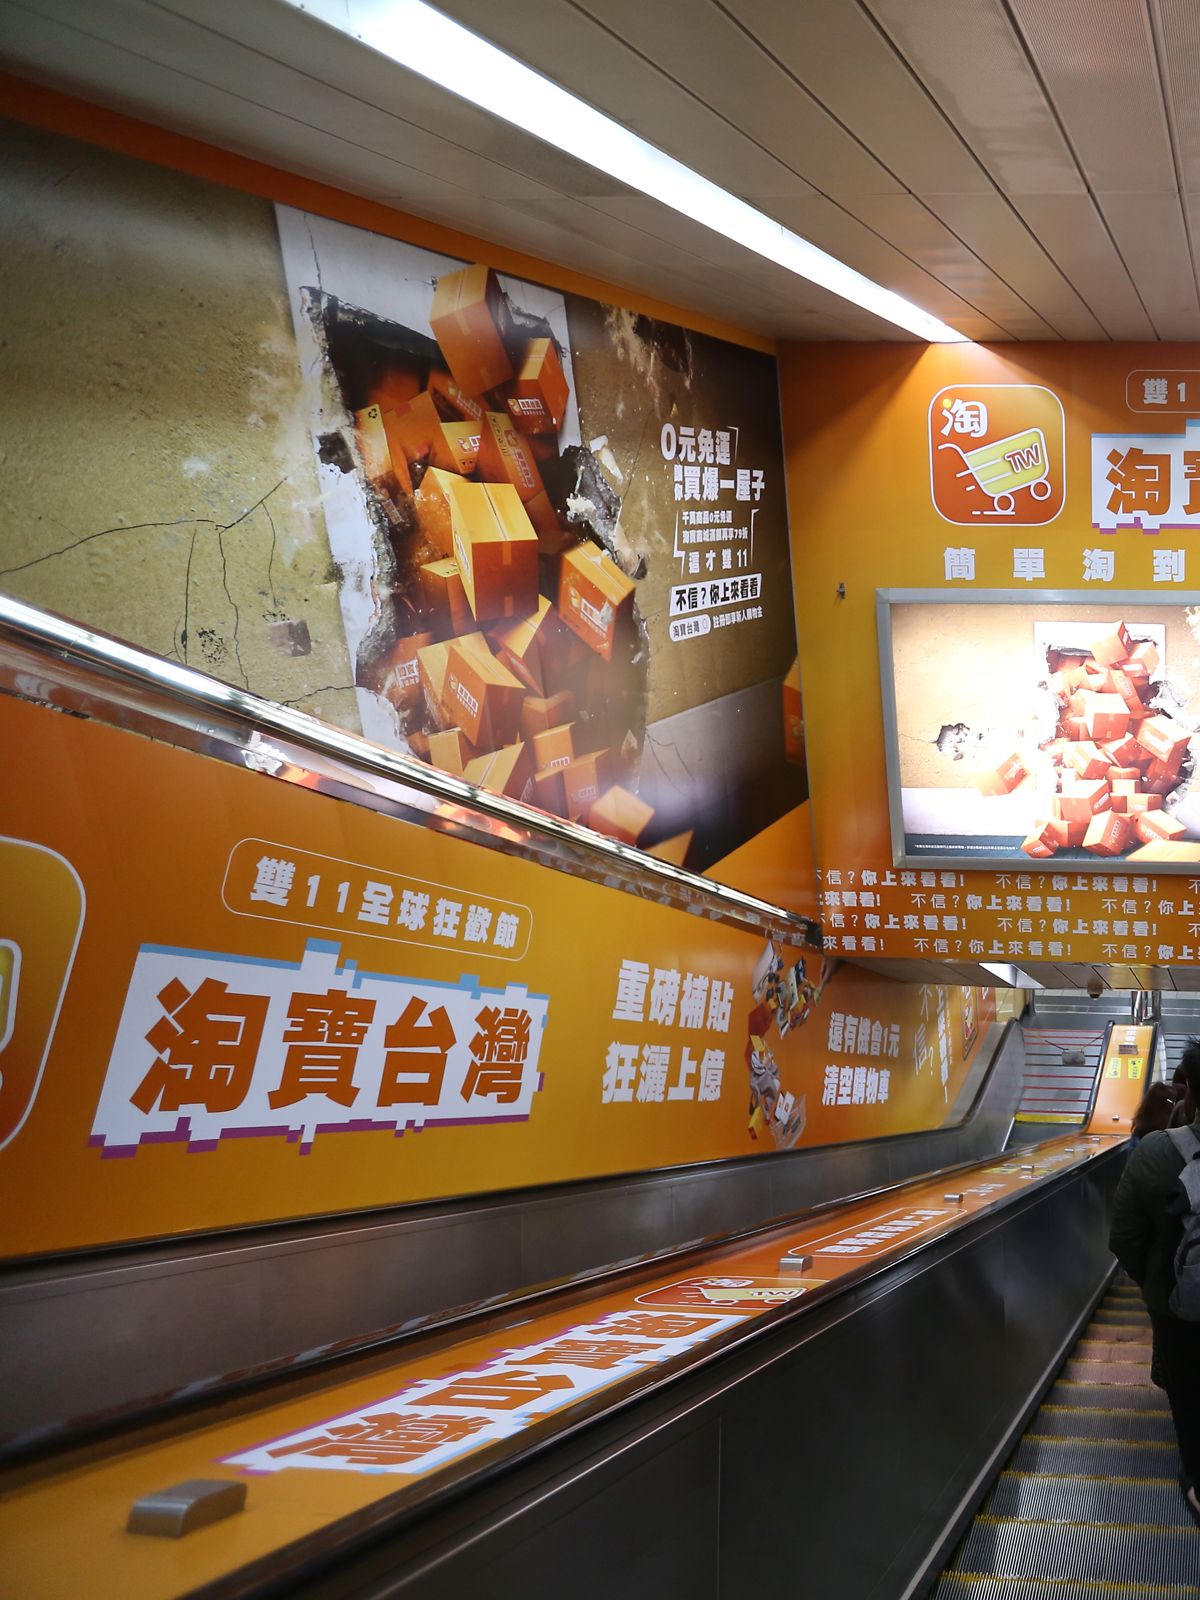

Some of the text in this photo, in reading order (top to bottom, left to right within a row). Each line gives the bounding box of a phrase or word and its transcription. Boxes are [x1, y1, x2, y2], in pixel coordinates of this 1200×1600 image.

[941, 398, 989, 437] 淘
[1004, 443, 1041, 475] TW
[249, 856, 521, 950] 雙11全球狂歡節
[612, 959, 734, 1033] 重磅補貼
[128, 977, 533, 1116] 淘寶台灣
[601, 1041, 726, 1105] 狂灑上億
[266, 1312, 700, 1465] 淘寶台灣
